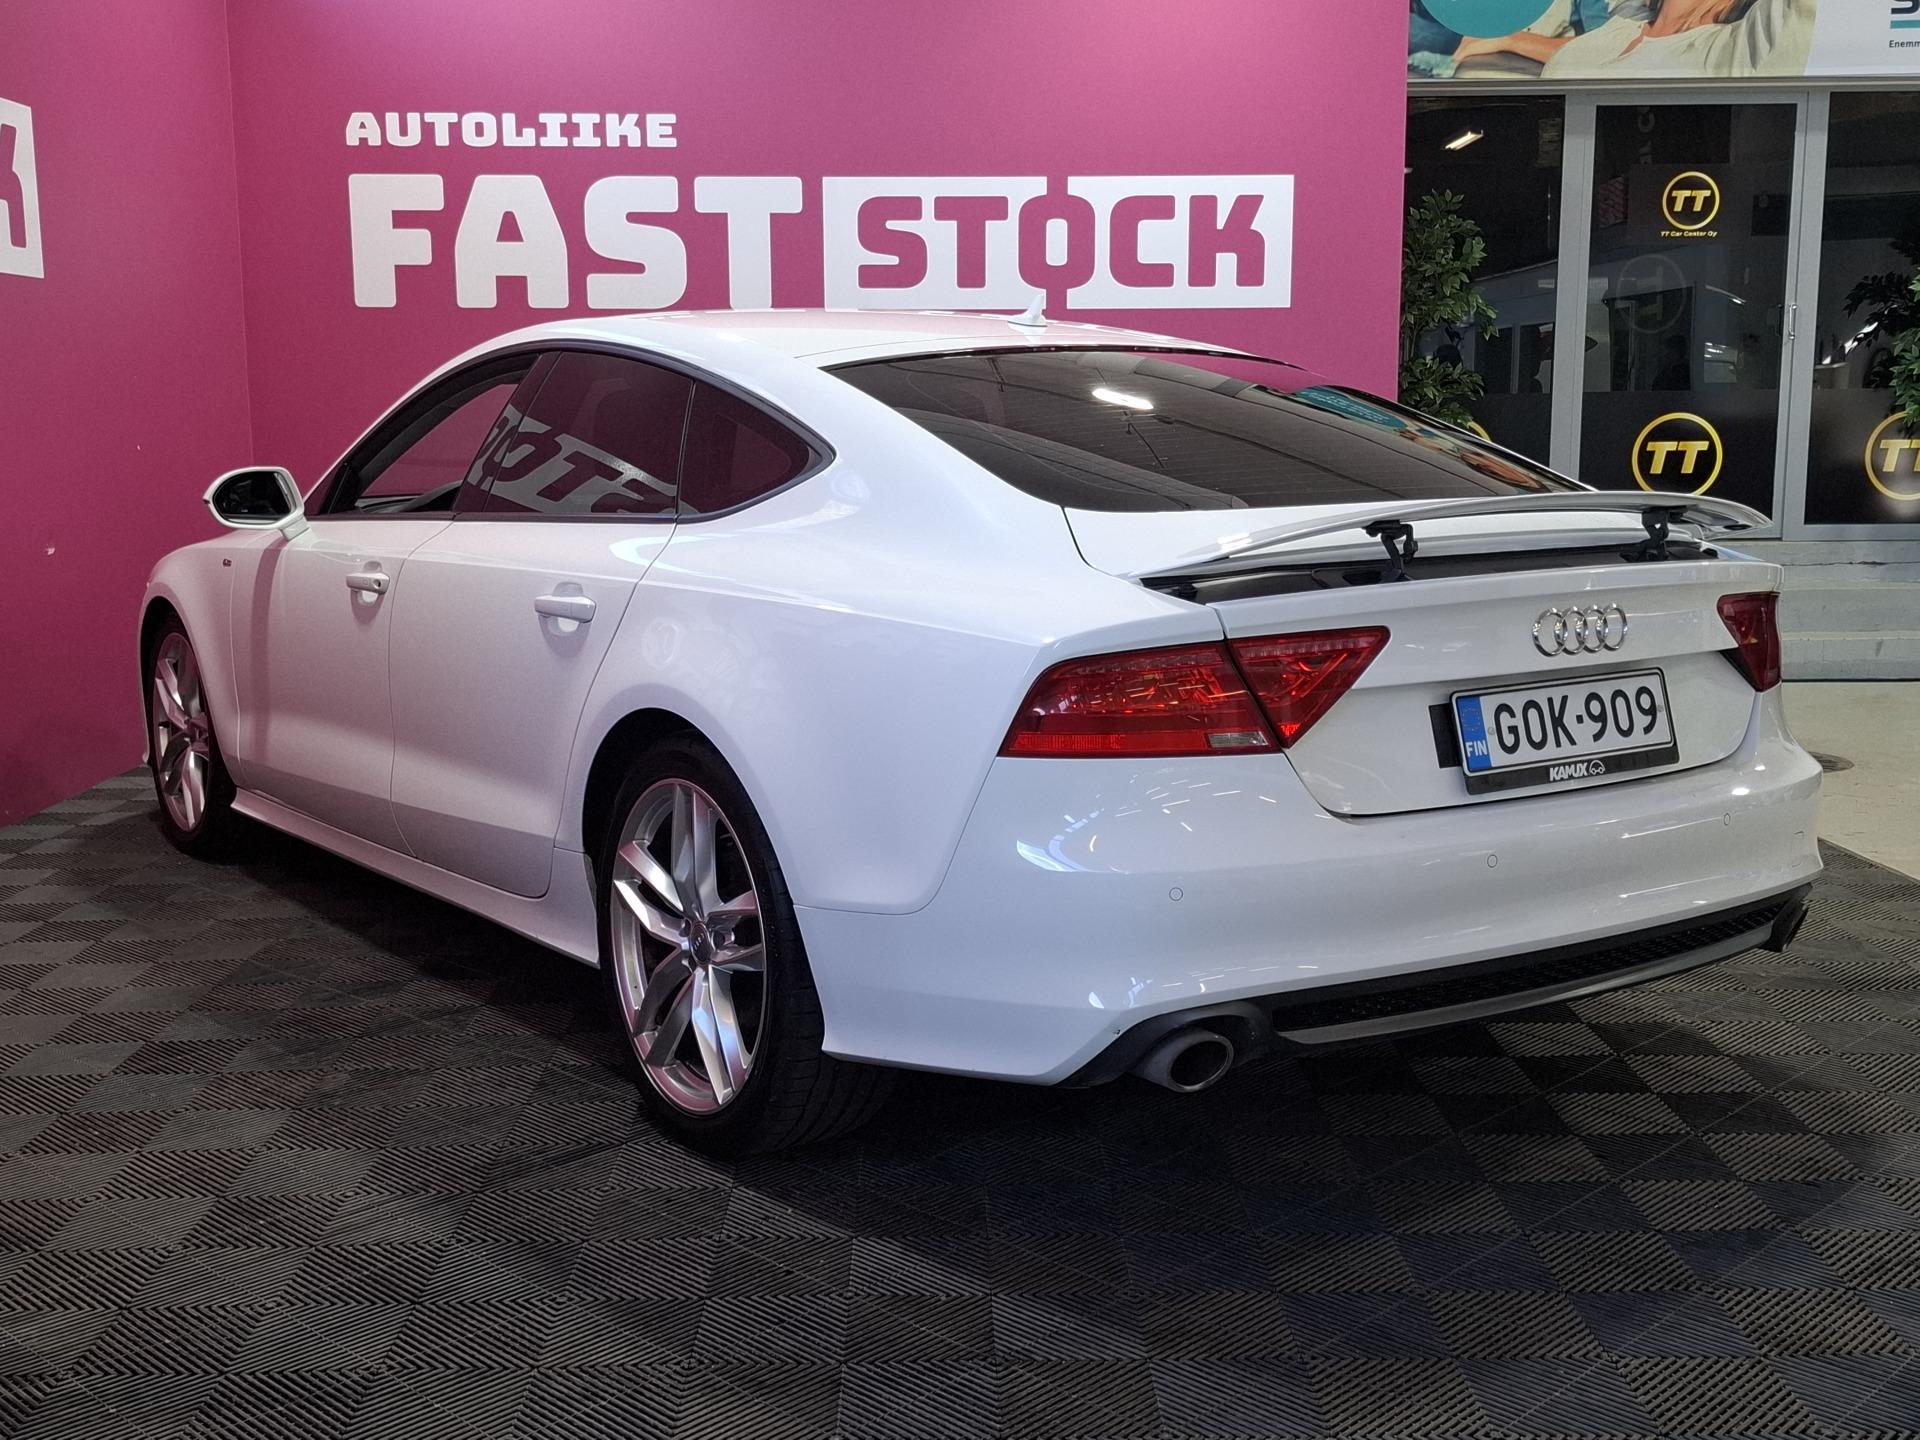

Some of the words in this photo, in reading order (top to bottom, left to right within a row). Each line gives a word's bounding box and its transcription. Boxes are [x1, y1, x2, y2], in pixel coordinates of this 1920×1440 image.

[346, 112, 677, 147] AUTOLIIKE
[1671, 190, 1711, 212] TT
[348, 174, 803, 309] FAST
[857, 194, 1265, 289] STOCK
[1646, 441, 1709, 475] TT
[1493, 685, 1658, 755] GOK-909
[1465, 739, 1488, 758] FIN
[1550, 762, 1588, 781] KAMUX
